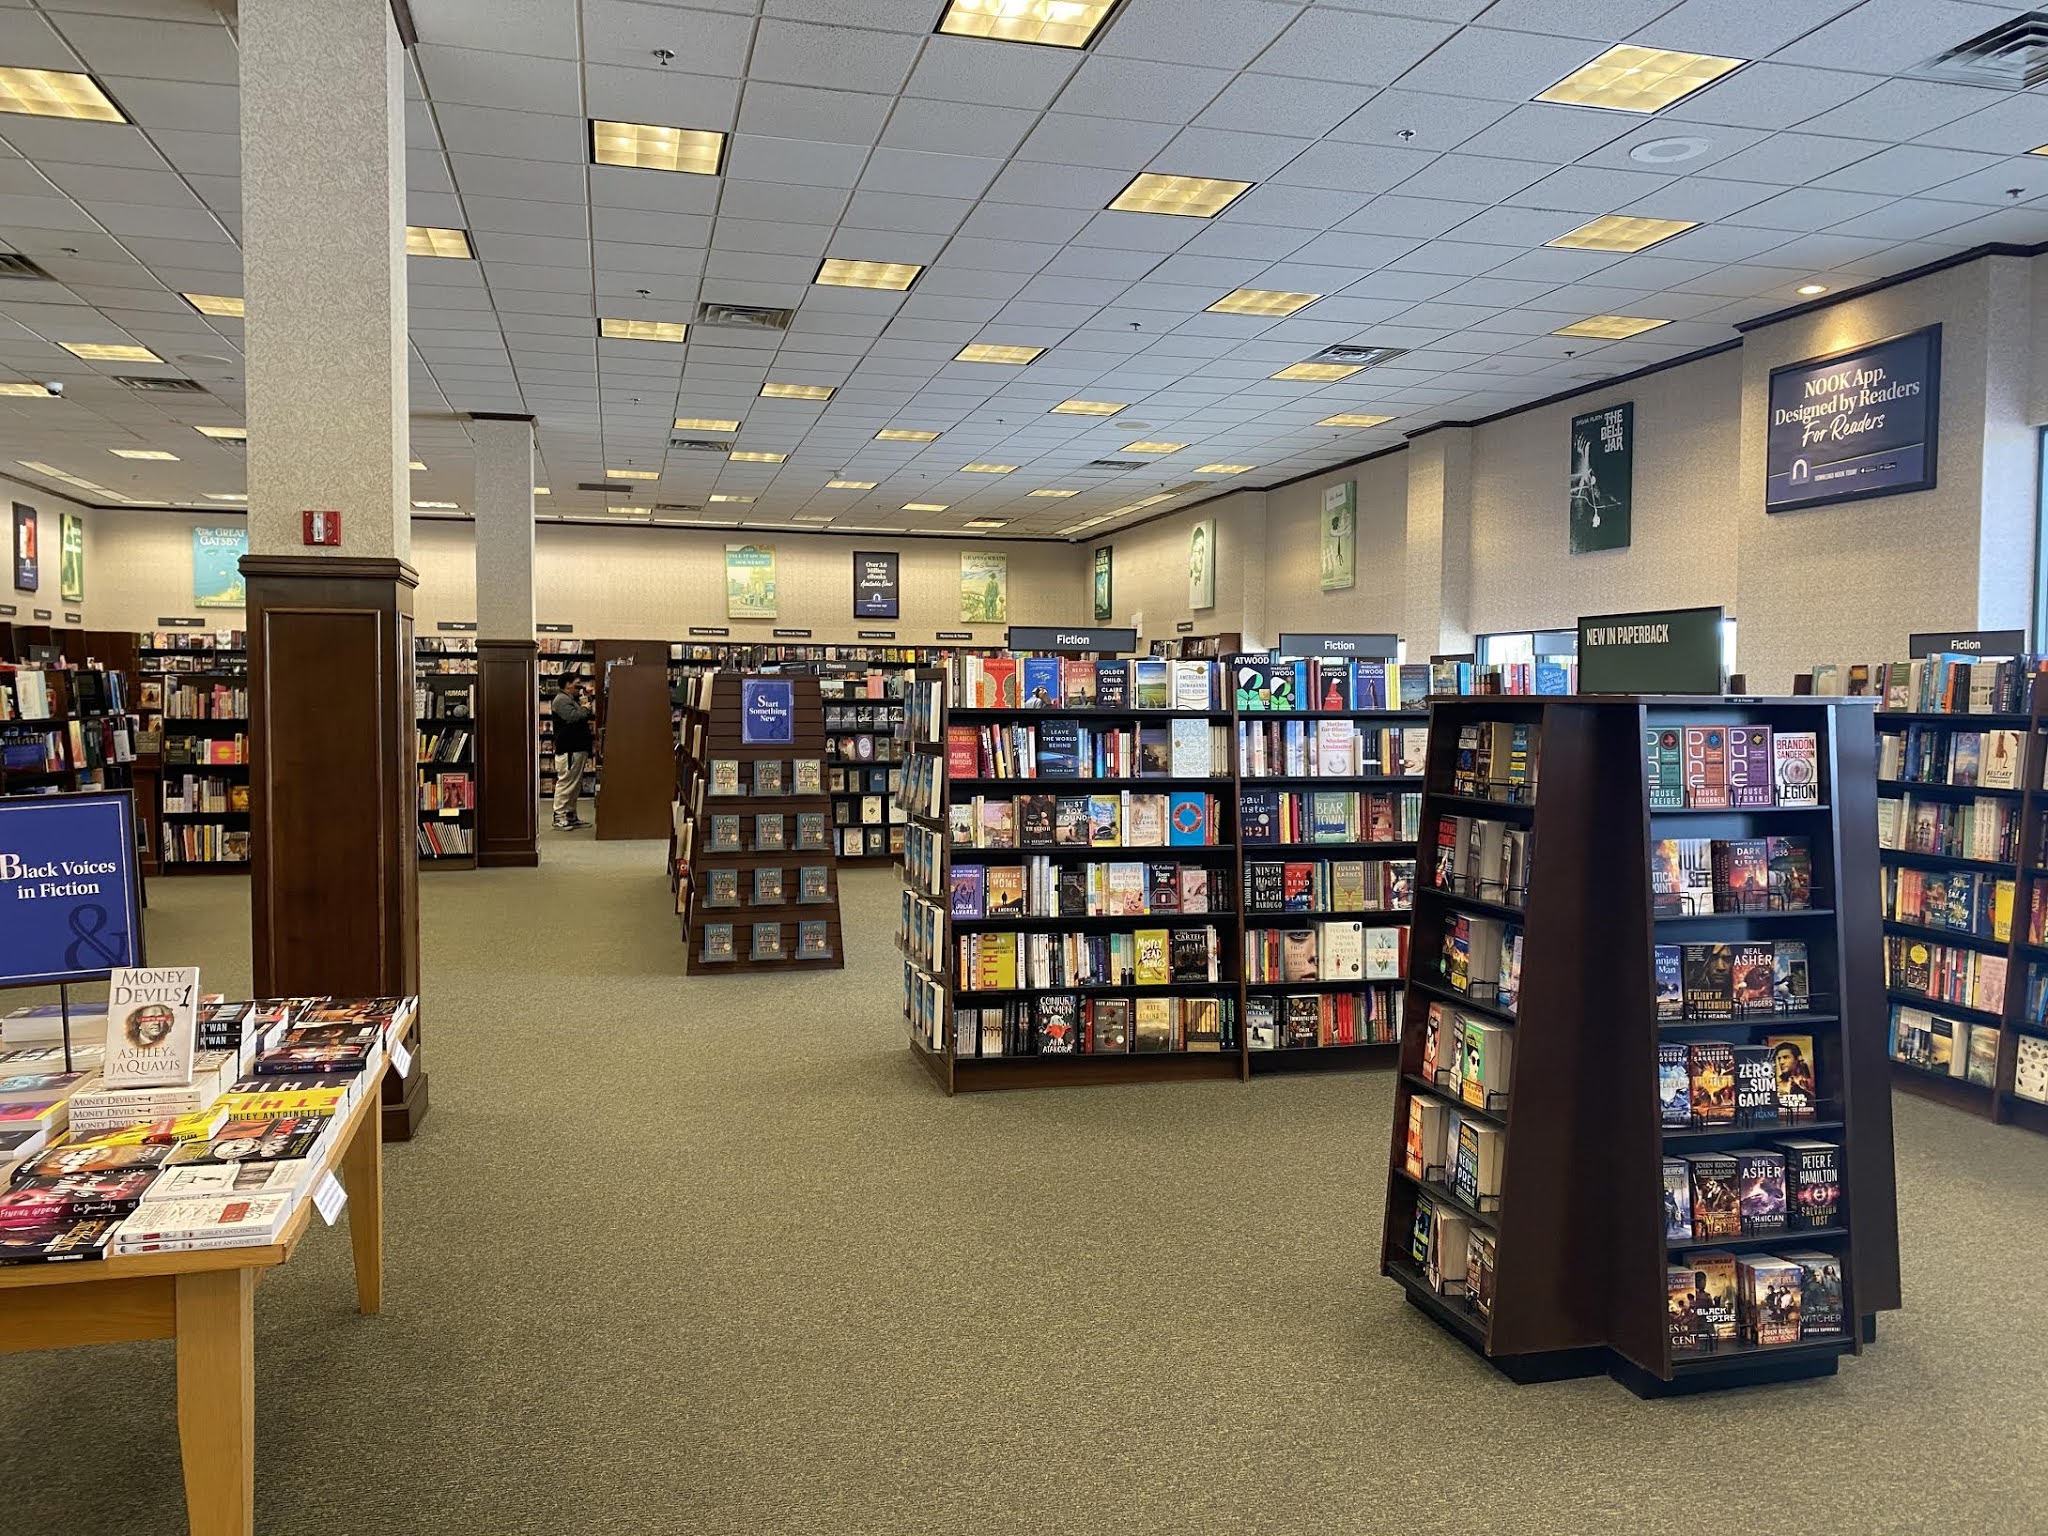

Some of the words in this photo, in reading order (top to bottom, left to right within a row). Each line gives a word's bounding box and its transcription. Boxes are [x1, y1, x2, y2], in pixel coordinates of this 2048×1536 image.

[1804, 371, 1851, 398] NOOK
[1852, 367, 1886, 390] App.
[1775, 393, 1837, 426] Designed
[1839, 391, 1858, 415] by
[1859, 381, 1920, 407] Readers
[1604, 409, 1623, 425] THE
[1601, 423, 1623, 441] BELL
[1802, 419, 1827, 448] For
[1831, 412, 1885, 440] Readers
[1605, 437, 1623, 453] JAR
[215, 528, 246, 537] GREAT
[200, 537, 240, 546] GATSBY
[1056, 634, 1090, 645] Fiction
[1586, 628, 1606, 646] NEW
[1607, 627, 1616, 645] IN
[1617, 624, 1669, 645] PAPERBACK
[1324, 640, 1355, 650] Fiction
[1951, 639, 1981, 650] Fiction
[1234, 656, 1269, 665] ATWOOD
[758, 695, 779, 707] Start
[749, 708, 787, 716] Something
[1777, 739, 1815, 750] BRANDON
[1777, 750, 1815, 759] SANDERSON
[1779, 785, 1816, 800] LEGION
[1240, 795, 1264, 806] paul
[1241, 805, 1270, 813] uster
[1316, 802, 1344, 815] BEAR
[1316, 815, 1345, 825] TOWN
[1240, 825, 1270, 837] 321
[1736, 847, 1761, 856] DARK
[0, 853, 58, 880] Black
[61, 861, 116, 876] Voices
[1255, 867, 1281, 876] NINTH
[1255, 877, 1282, 886] HOUSE
[1652, 871, 1676, 883] ITICAL
[1688, 871, 1711, 888] SET
[993, 879, 1017, 888] HOME
[1652, 882, 1673, 893] OINT
[18, 885, 36, 899] in
[39, 882, 100, 898] Fiction
[1256, 891, 1282, 901] LEIGH
[1137, 938, 1163, 949] MOSTLY
[983, 934, 998, 987] ETHIC
[1141, 949, 1162, 960] DEAD
[1733, 954, 1772, 966] ASHER
[1658, 966, 1676, 974] Man
[120, 970, 186, 986] MONEY
[114, 987, 182, 1005] DEVILS
[179, 984, 192, 1008] 1
[201, 1022, 228, 1033] K'WAN
[200, 1036, 227, 1045] K'WAN
[1739, 1062, 1773, 1079] ZERO
[1750, 1078, 1776, 1092] SUM
[74, 1097, 104, 1107] MONEY
[107, 1096, 136, 1105] DEVILS
[1738, 1092, 1771, 1108] GAME
[73, 1109, 104, 1119] MONEY
[107, 1107, 135, 1117] DEVILS
[228, 1111, 263, 1122] SHLEY
[263, 1109, 324, 1120] ANTOINETTE
[74, 1121, 105, 1131] MONEY
[108, 1119, 137, 1129] DEVILS
[1802, 1155, 1826, 1169] PETER
[1827, 1154, 1834, 1168] F.
[1742, 1166, 1782, 1179] ASHER
[1800, 1169, 1838, 1184] HAMILTON
[1801, 1205, 1837, 1217] SALVATION
[1812, 1215, 1828, 1226] LOST
[1696, 1307, 1727, 1316] BLACK
[1706, 1314, 1736, 1323] SPIRE
[1800, 1314, 1841, 1323] WITCHER
